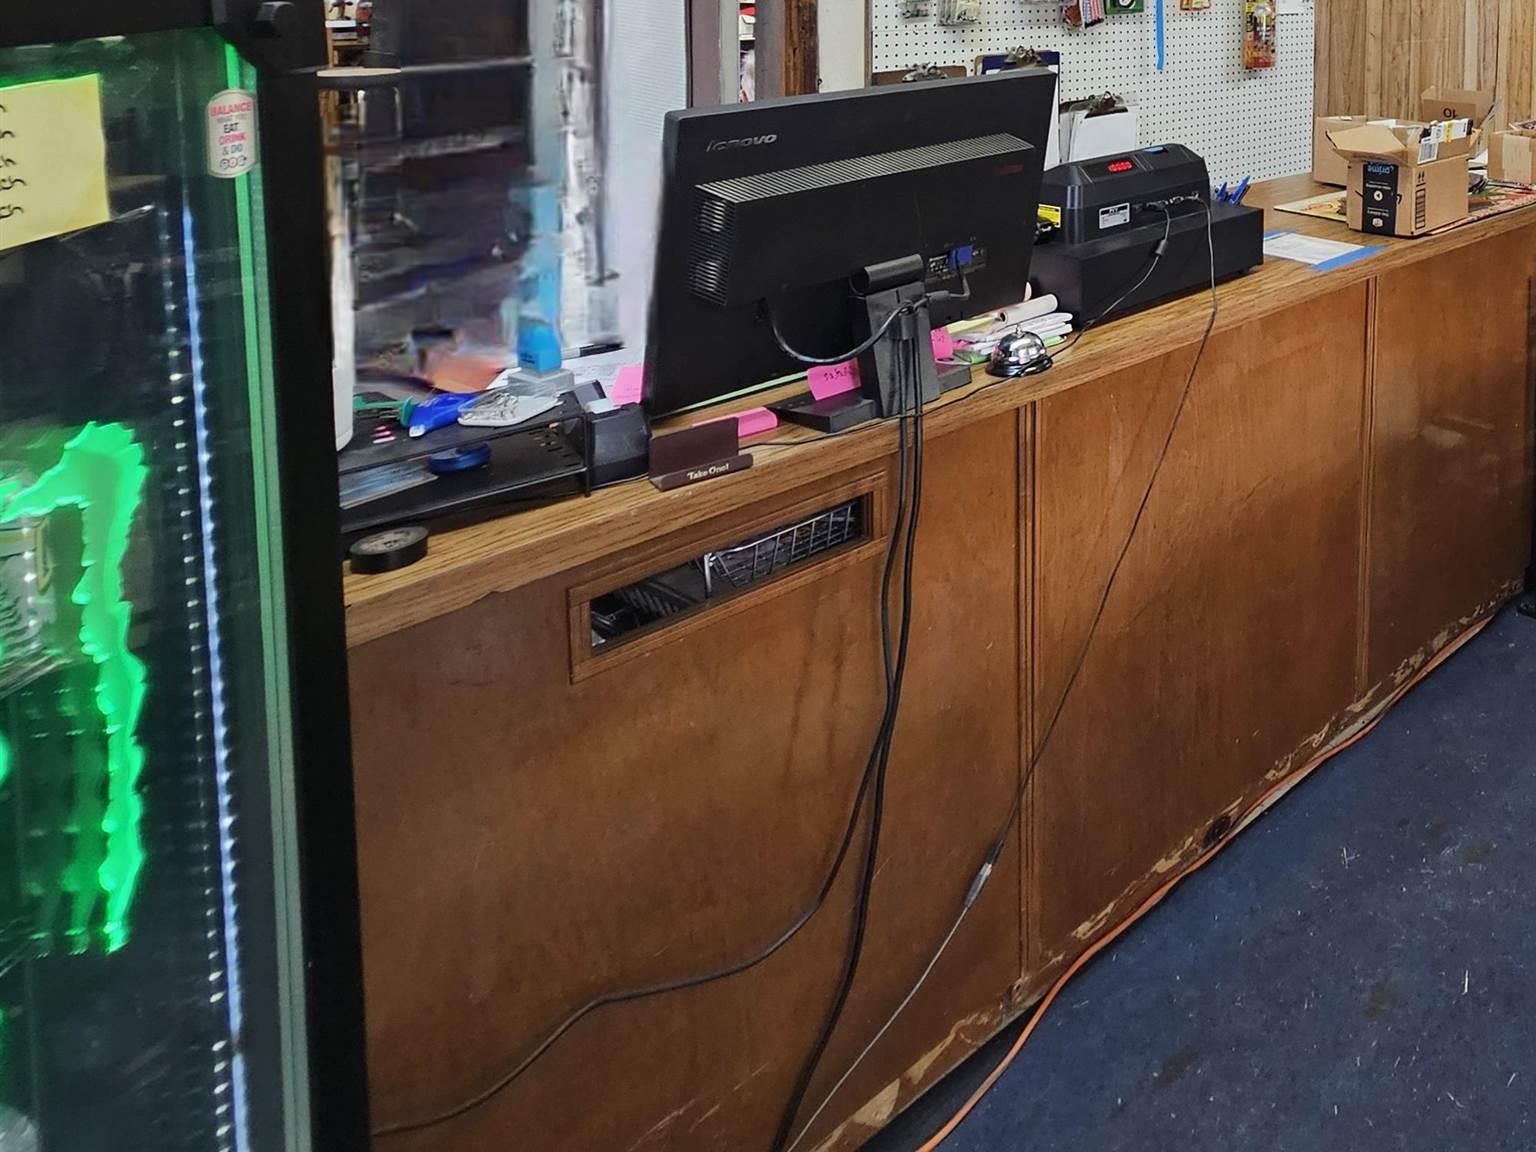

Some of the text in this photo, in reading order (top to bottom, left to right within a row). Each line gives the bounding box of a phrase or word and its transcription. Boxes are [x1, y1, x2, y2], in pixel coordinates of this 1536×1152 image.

[224, 122, 239, 133] EAT
[686, 463, 730, 480] Take One!
